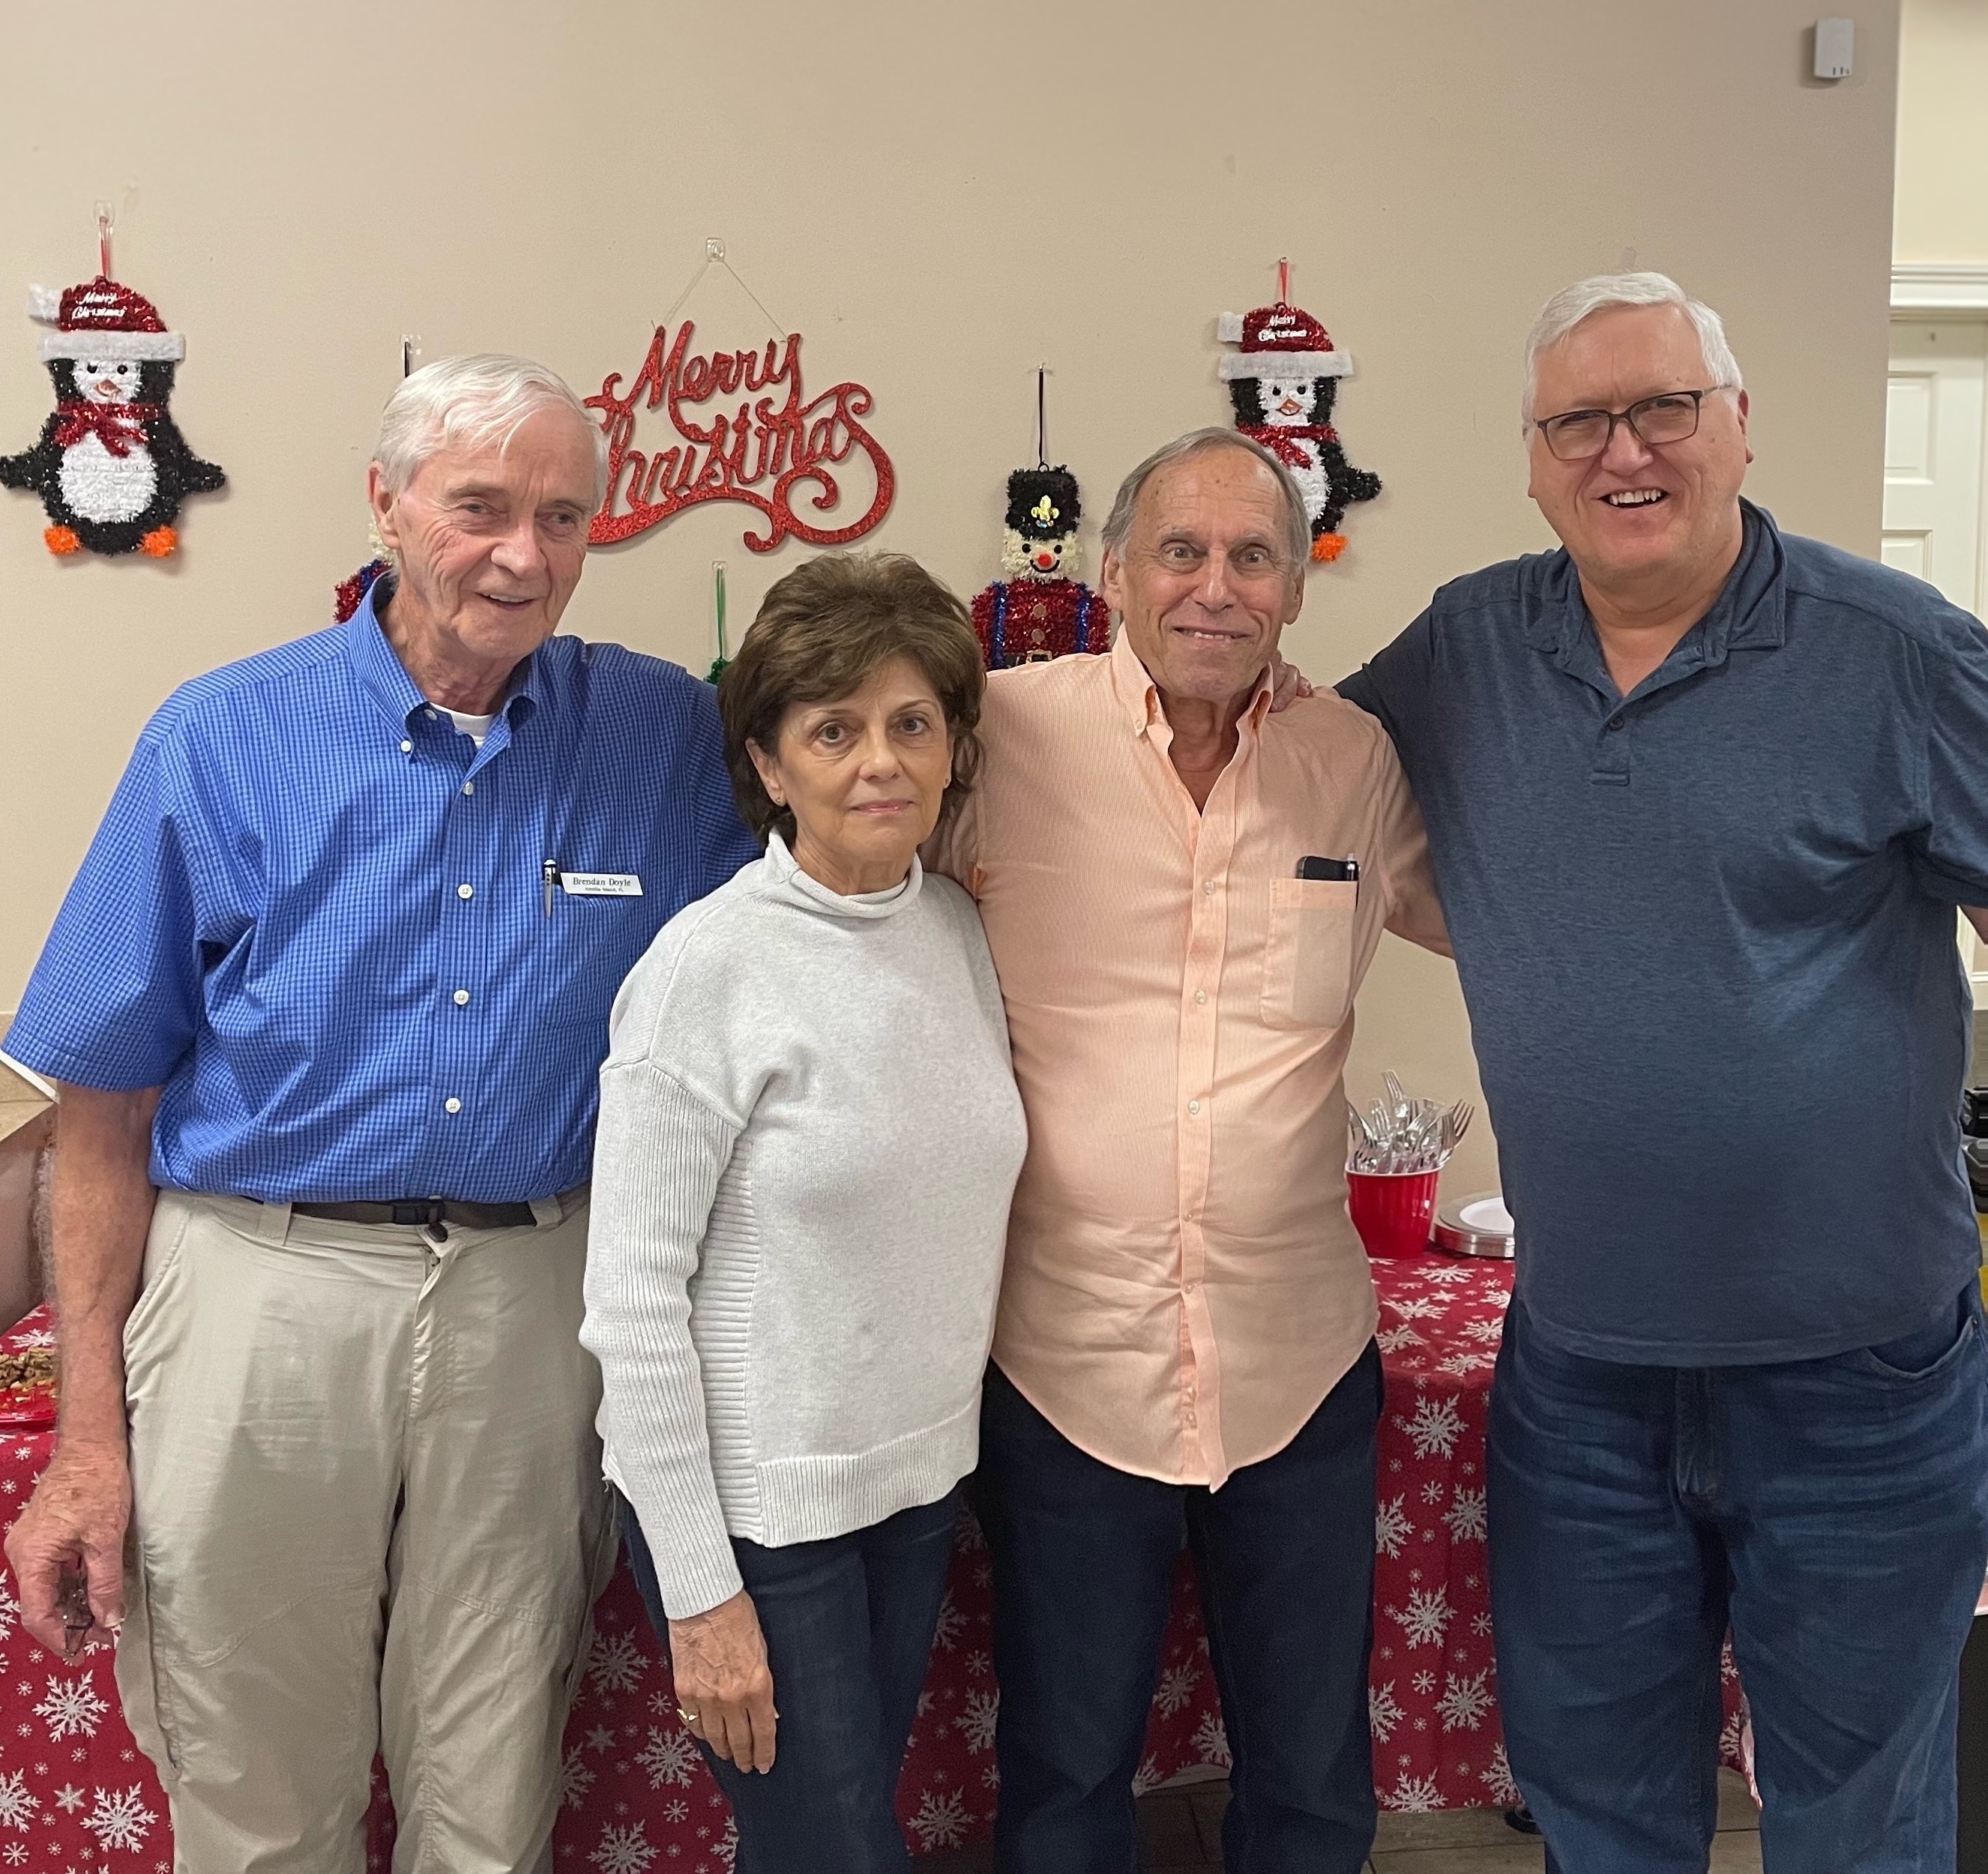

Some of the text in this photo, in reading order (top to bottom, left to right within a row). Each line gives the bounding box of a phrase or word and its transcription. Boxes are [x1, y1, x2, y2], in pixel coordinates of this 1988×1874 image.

[603, 320, 801, 420] Merry
[573, 877, 631, 887] Brendan Doyle
